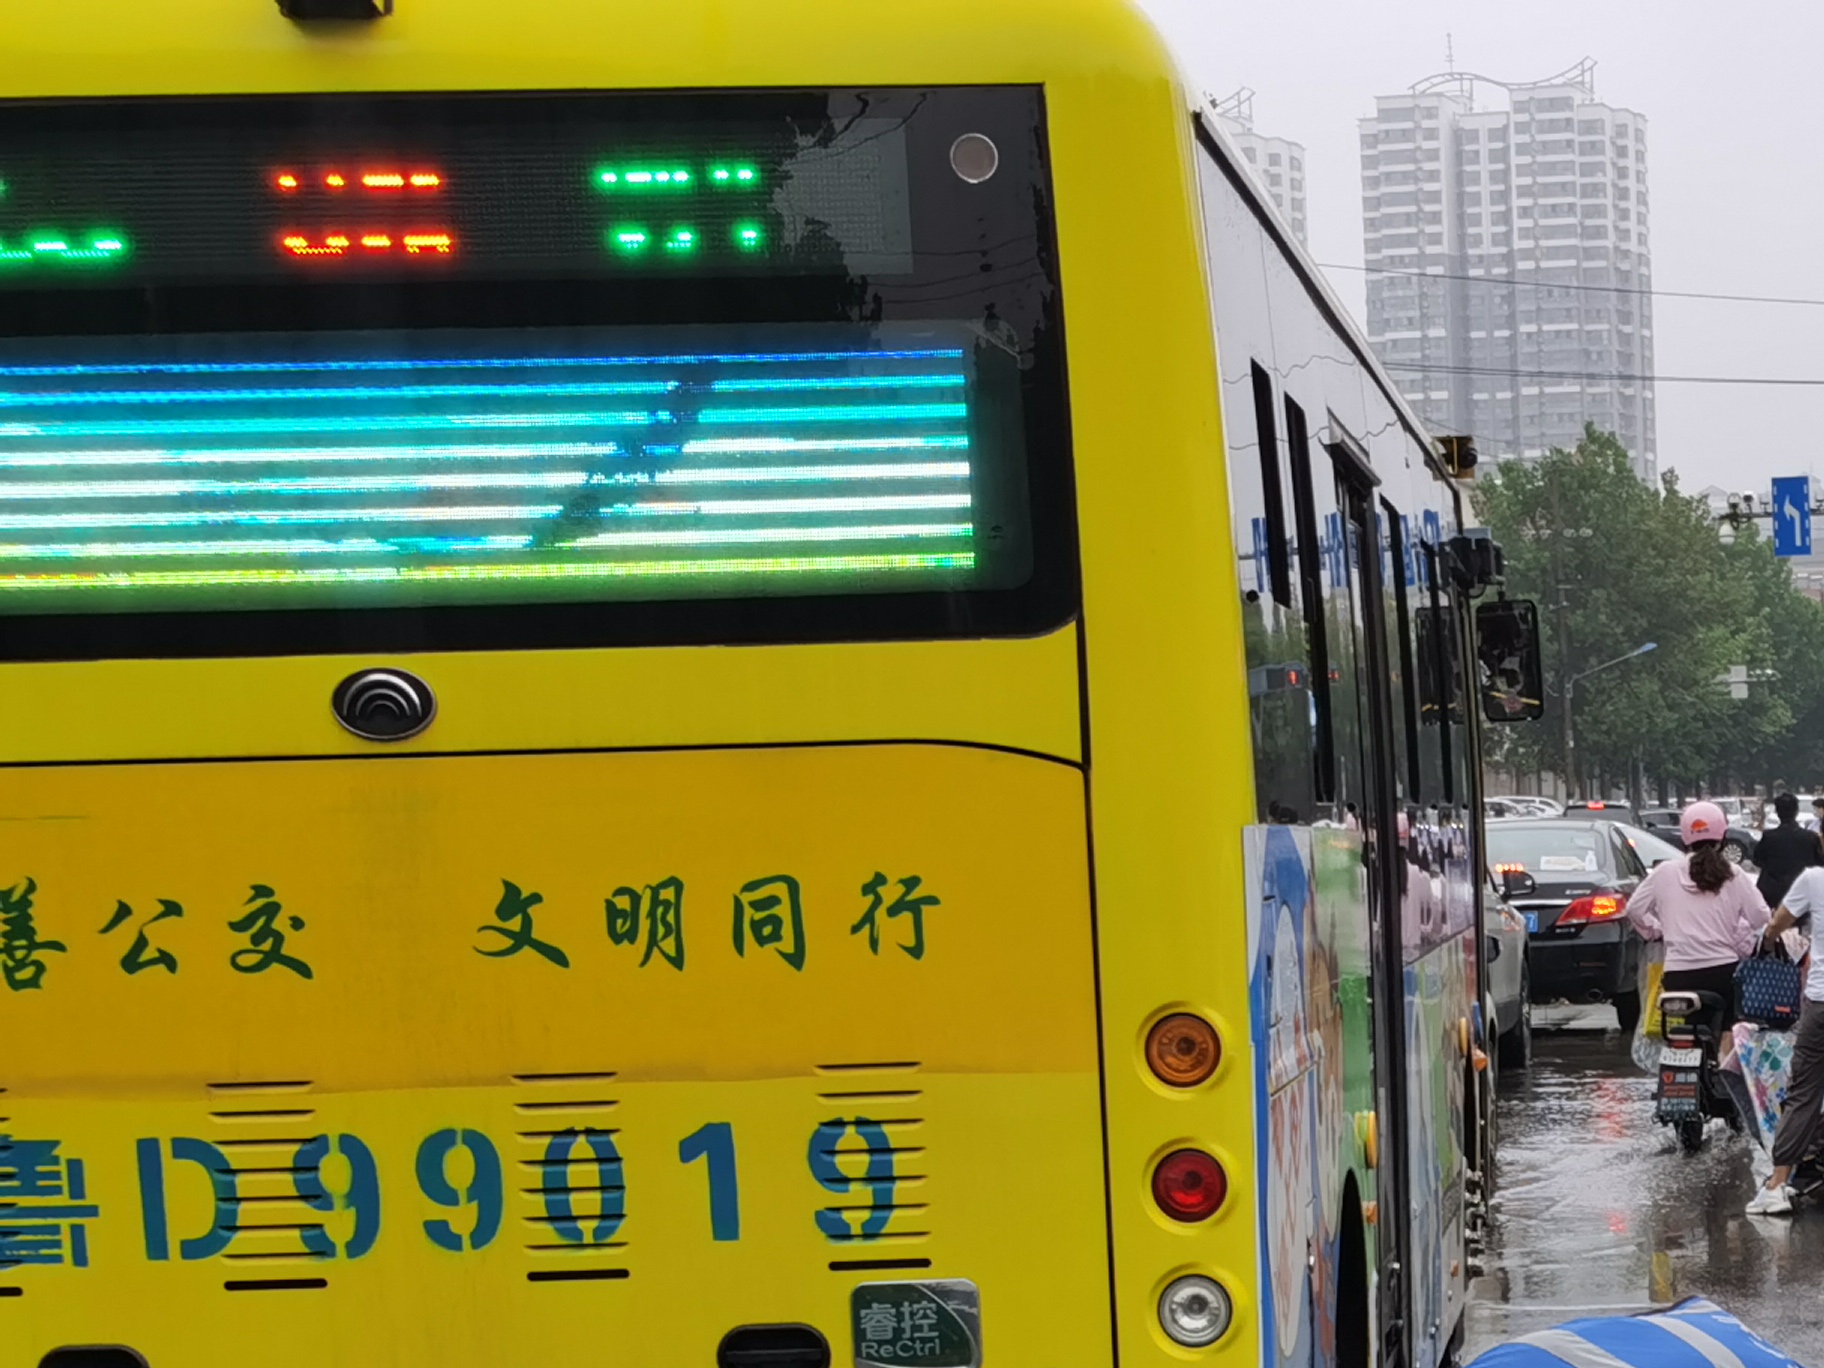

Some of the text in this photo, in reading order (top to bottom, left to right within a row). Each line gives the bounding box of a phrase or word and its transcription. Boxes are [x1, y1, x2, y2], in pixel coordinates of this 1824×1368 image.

[472, 871, 941, 972] 文明同行
[859, 1301, 940, 1341] 睿控
[861, 1339, 941, 1359] ReCtrl
